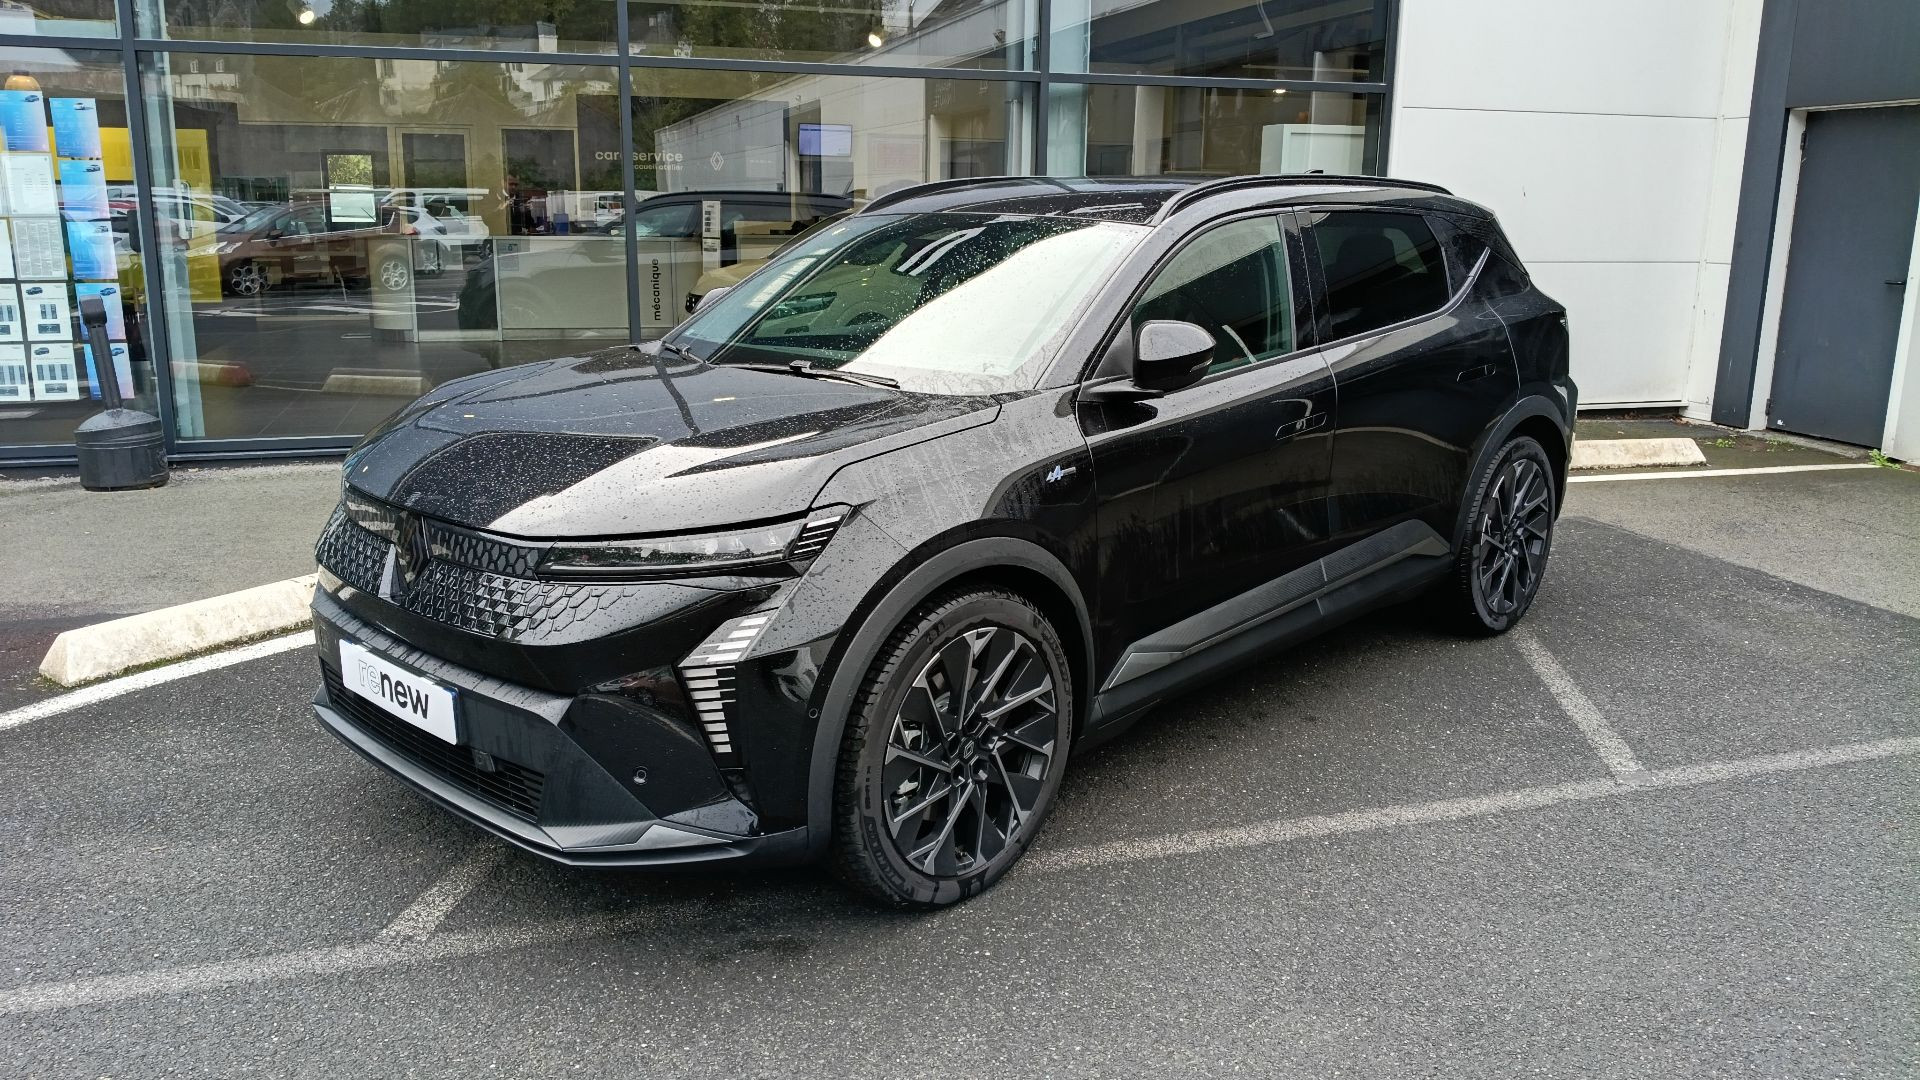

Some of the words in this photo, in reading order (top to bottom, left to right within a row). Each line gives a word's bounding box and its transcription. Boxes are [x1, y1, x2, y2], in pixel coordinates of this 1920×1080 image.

[595, 151, 623, 161] car
[632, 150, 683, 162] service
[650, 258, 662, 321] mécanique
[357, 659, 430, 720] renew
